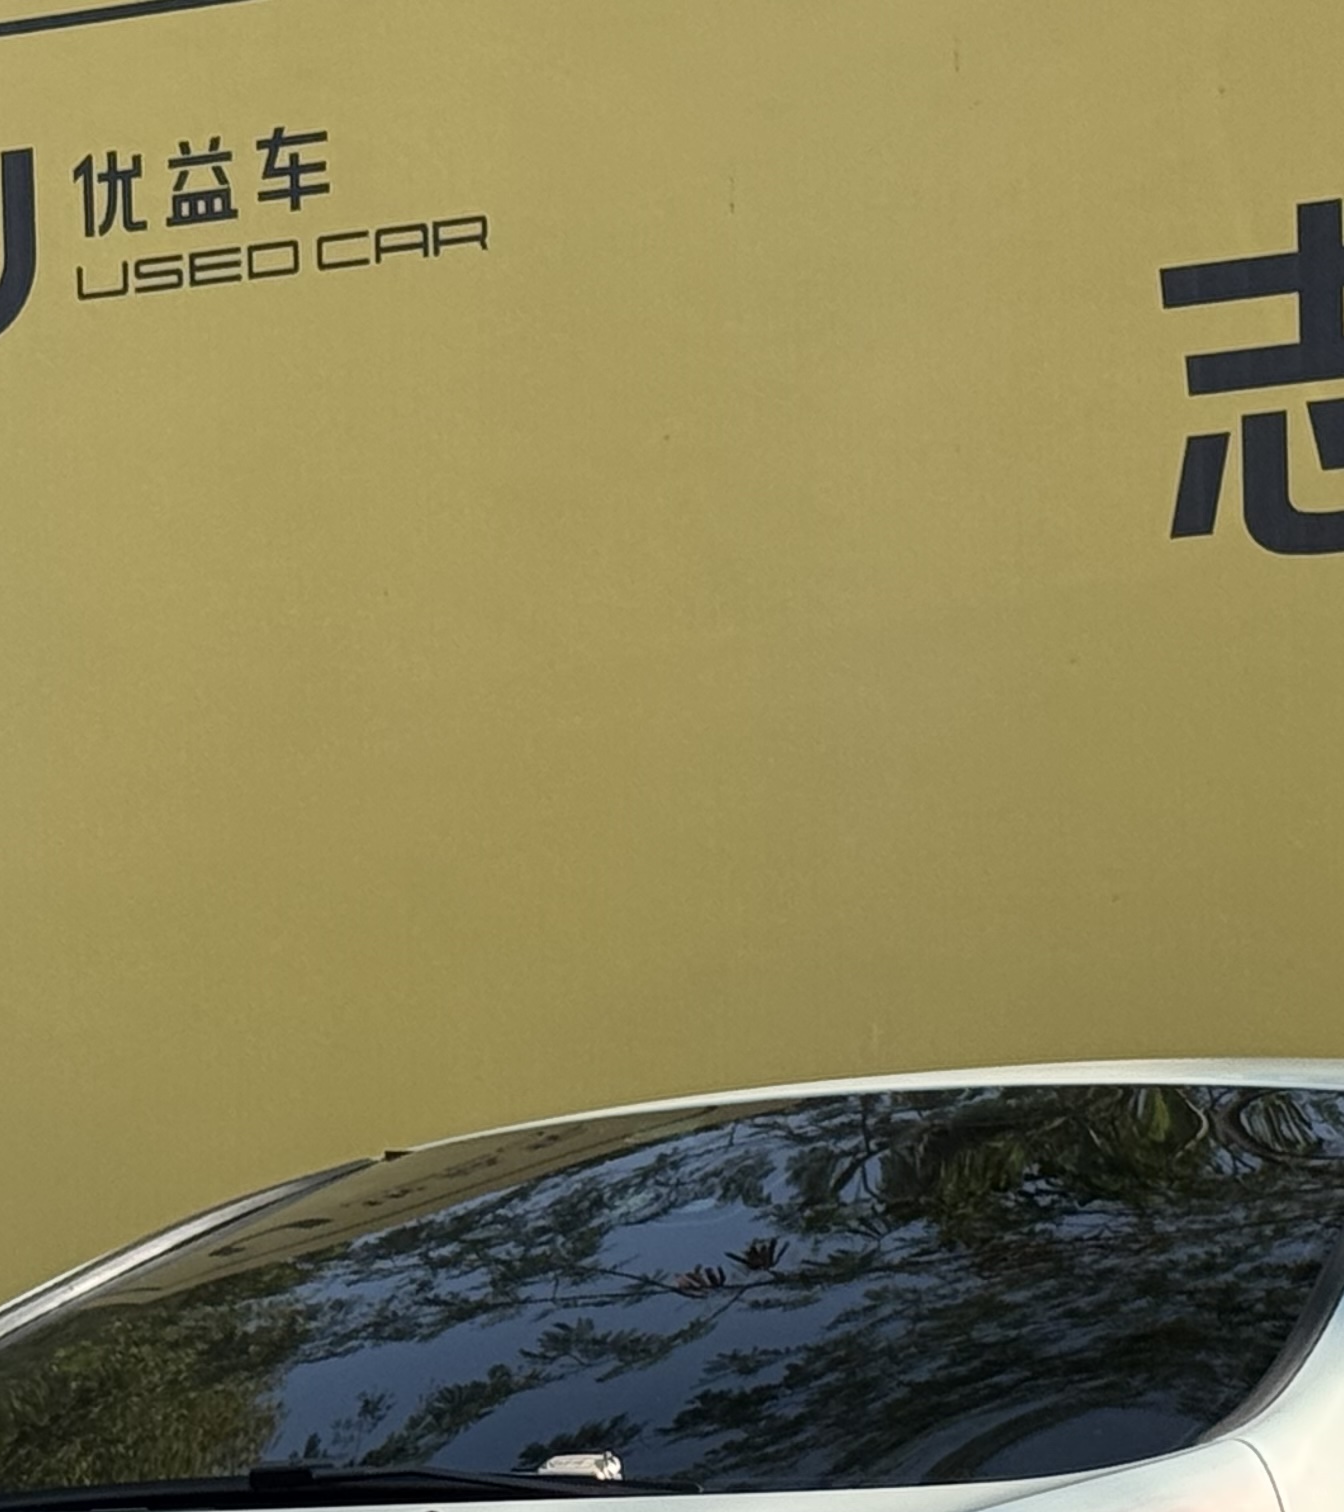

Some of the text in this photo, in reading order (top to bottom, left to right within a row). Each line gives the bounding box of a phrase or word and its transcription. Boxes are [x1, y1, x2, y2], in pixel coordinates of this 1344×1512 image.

[72, 127, 330, 238] 优益车
[76, 215, 488, 300] USED CAR
